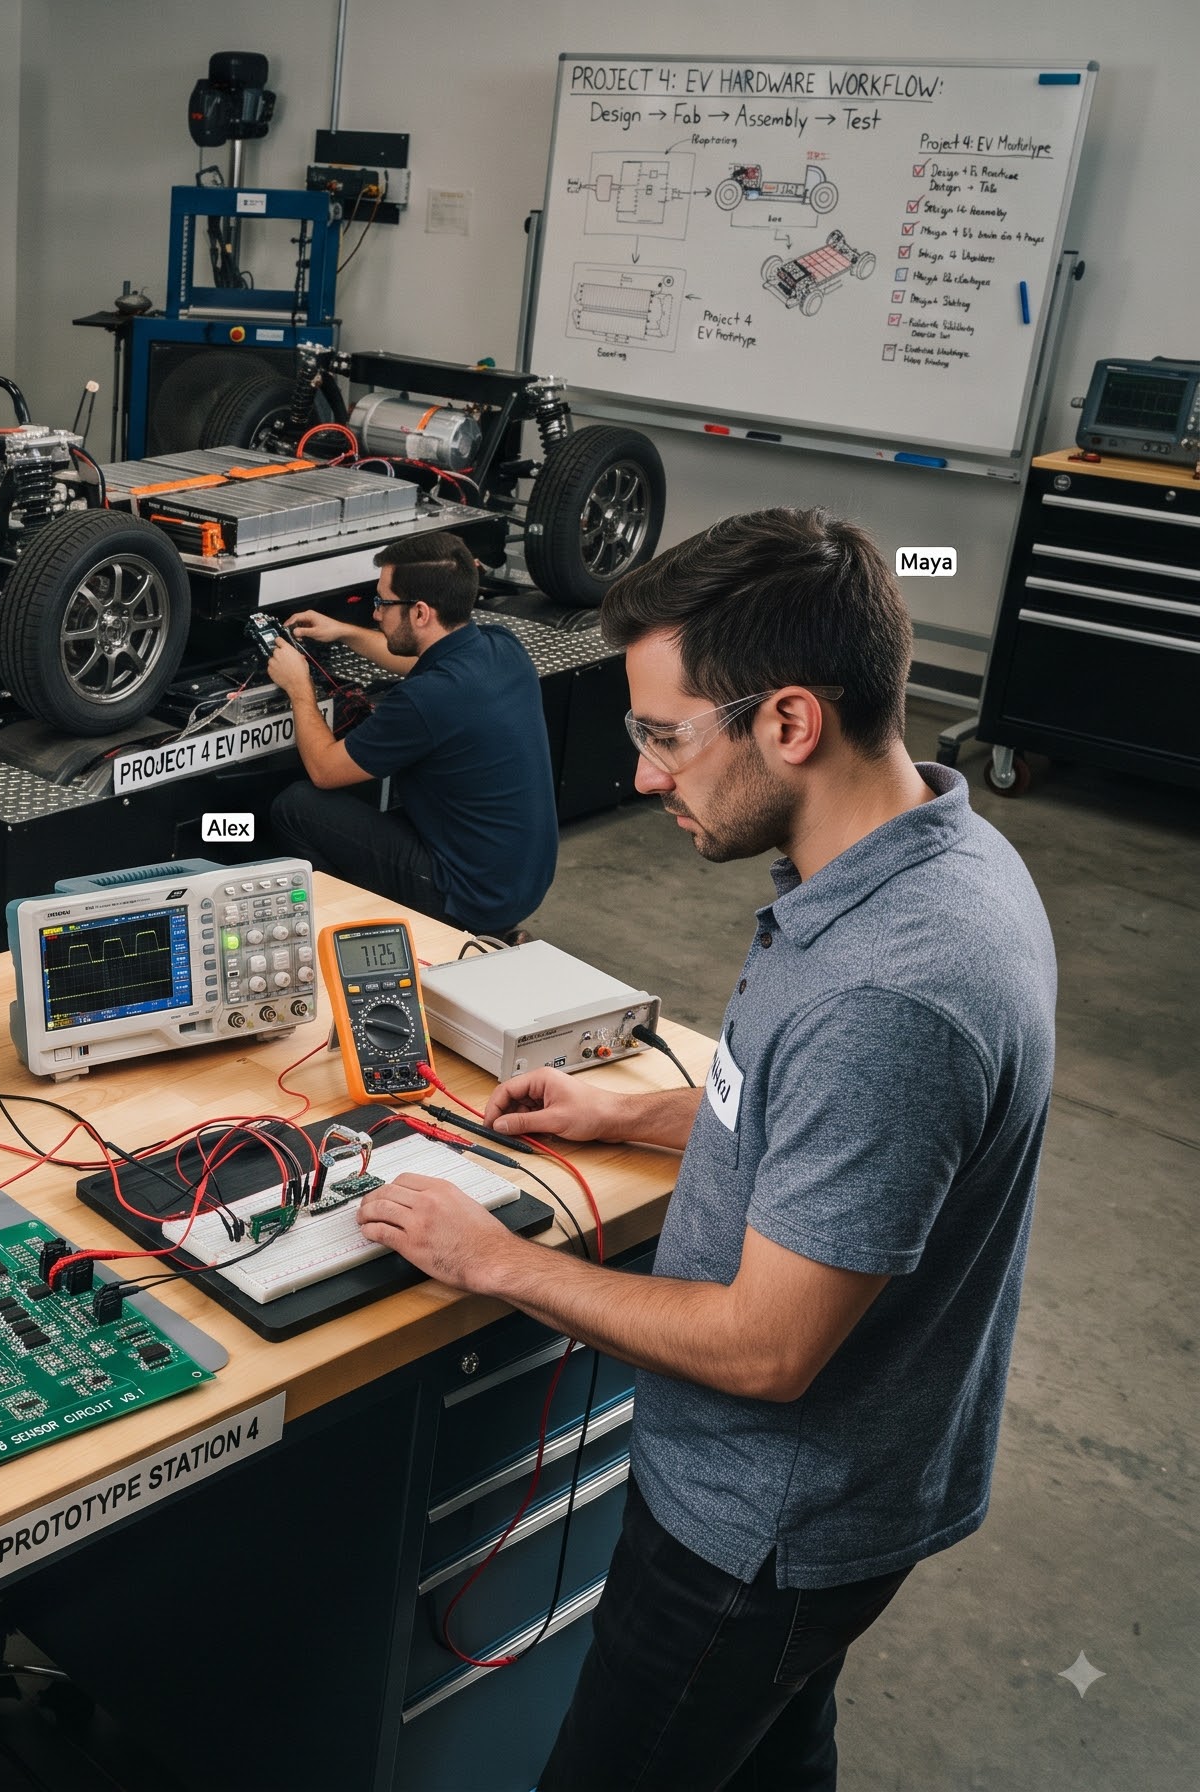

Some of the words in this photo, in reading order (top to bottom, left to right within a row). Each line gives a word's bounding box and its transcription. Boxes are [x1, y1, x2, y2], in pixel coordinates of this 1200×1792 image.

[571, 65, 653, 91] PROJECT
[659, 68, 676, 91] 4:
[685, 69, 714, 93] EV
[719, 69, 816, 94] HARDWARE
[590, 101, 641, 131] Design
[673, 102, 701, 125] Fab
[734, 103, 808, 138] Assembly
[842, 108, 882, 130] Test
[977, 136, 994, 152] EV
[703, 309, 740, 326] Project
[744, 314, 752, 327] 4
[697, 325, 713, 340] EV
[120, 744, 196, 785] PROJECT
[201, 740, 210, 762] 4
[215, 734, 235, 760] EV
[240, 717, 294, 753] PROTO
[10, 1420, 60, 1445] SENSOR
[149, 1429, 241, 1490] STATION
[246, 1416, 259, 1441] 4
